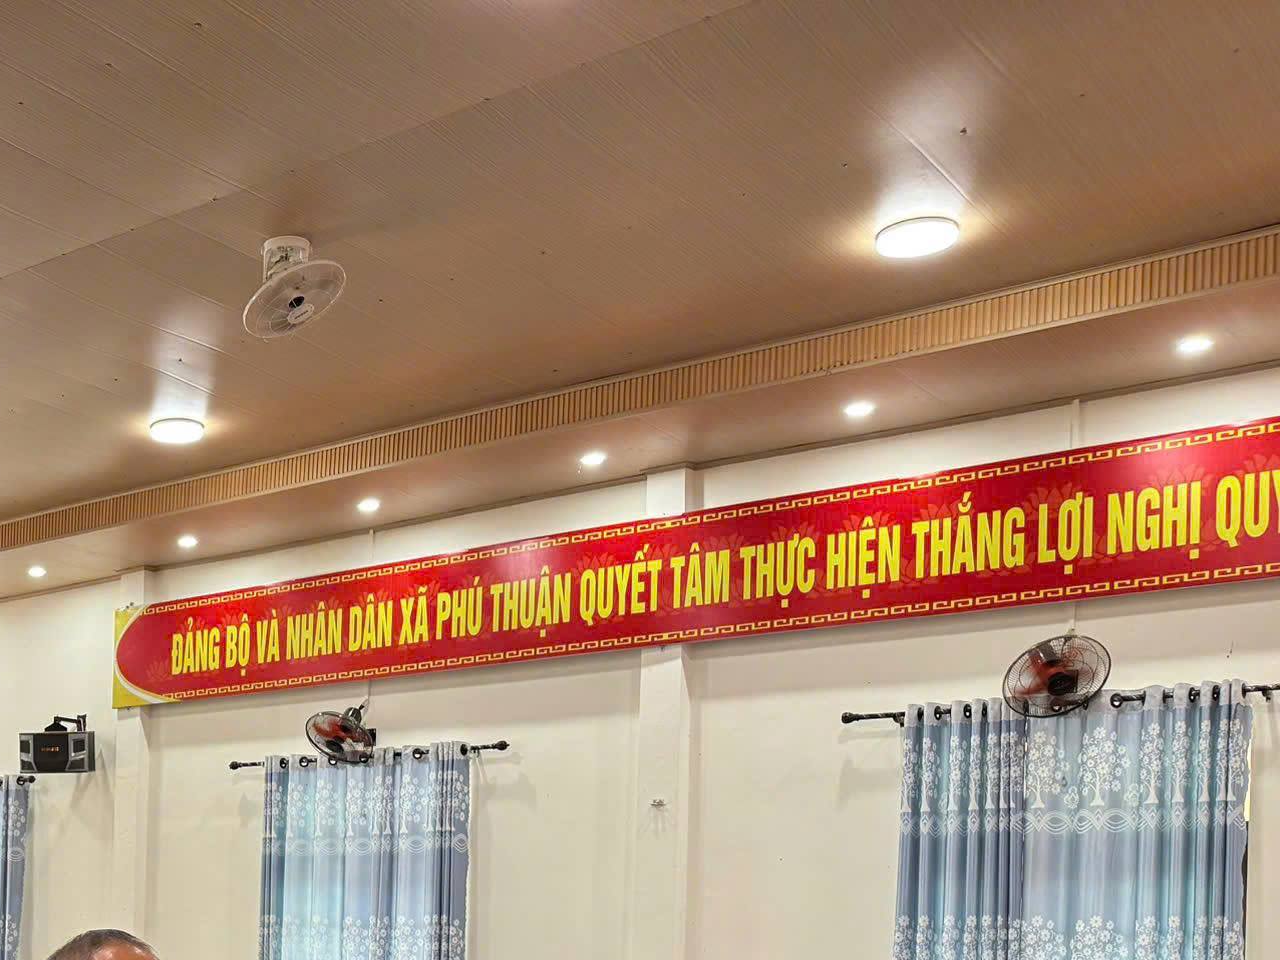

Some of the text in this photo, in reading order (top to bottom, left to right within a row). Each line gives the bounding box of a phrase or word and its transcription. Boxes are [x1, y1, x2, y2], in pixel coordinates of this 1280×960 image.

[171, 616, 221, 675] ĐẢNG
[225, 613, 251, 677] BỘ
[256, 608, 281, 664] VÀ
[285, 601, 343, 661] NHÂN
[348, 593, 393, 652] DÂN
[398, 585, 429, 646] XÃ
[435, 576, 483, 640] PHÚ
[489, 566, 572, 638] THUẬN
[579, 543, 663, 626] QUYẾT
[669, 542, 731, 609] TÂM
[739, 533, 816, 608] THỰC
[826, 515, 901, 599] HIỆN
[911, 491, 1025, 579] THẮNG
[1037, 491, 1094, 575] LỢI
[1106, 480, 1202, 560] NGHỊ
